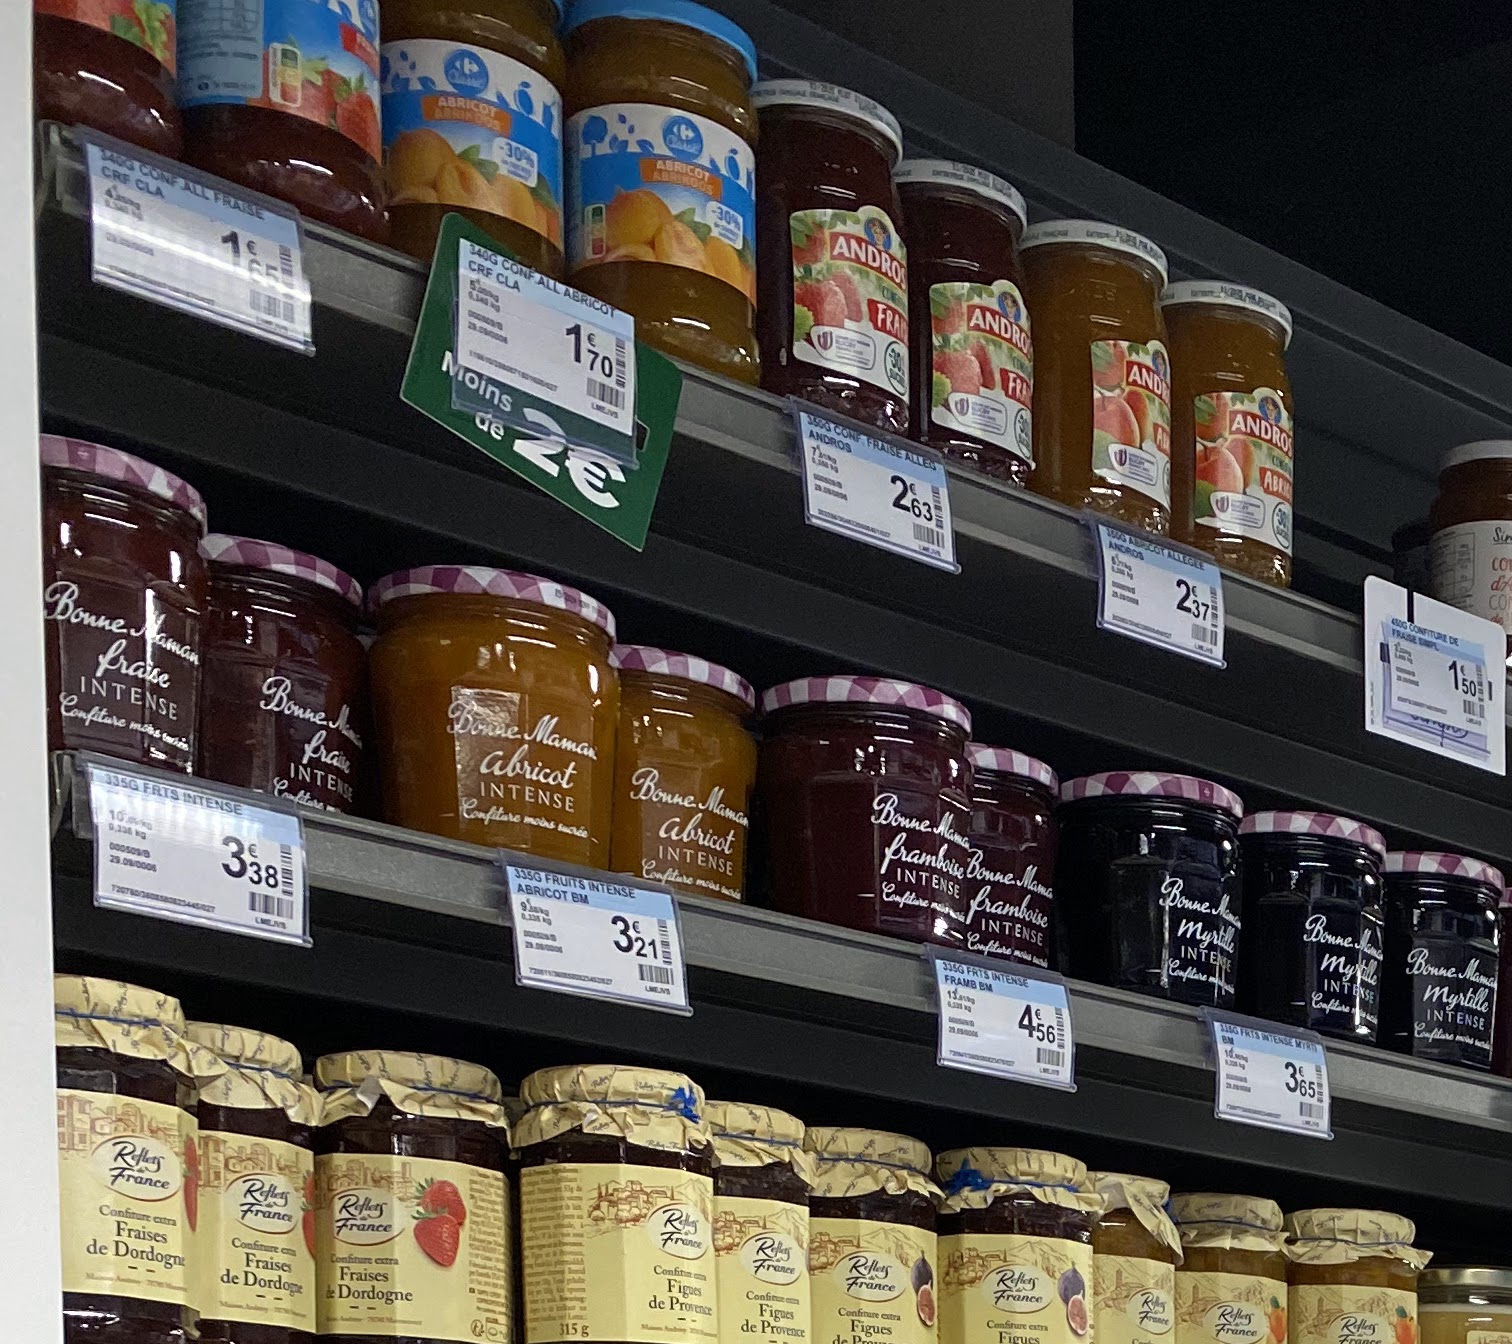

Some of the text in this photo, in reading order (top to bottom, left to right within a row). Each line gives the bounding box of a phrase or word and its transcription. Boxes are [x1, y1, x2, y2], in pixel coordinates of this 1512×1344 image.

[436, 96, 498, 116] ABRICOT
[467, 261, 521, 293] CRF CLA
[562, 285, 616, 319] ABRICOT
[441, 349, 513, 413] Moins
[475, 409, 505, 441] de
[513, 409, 626, 508] 2€
[47, 581, 126, 634] Bonne
[96, 642, 171, 690] fraise
[81, 676, 178, 721] INTENSE
[449, 701, 598, 760] Bonne Maman
[481, 750, 575, 791] abricot
[481, 780, 575, 813] INTENSE
[881, 833, 965, 880] framboise
[517, 884, 568, 903] ABRICOT
[588, 881, 636, 899] INTENSE
[897, 868, 960, 899] INTENSE
[1406, 948, 1458, 978] Bonne
[944, 975, 975, 991] FRAMB
[1425, 984, 1490, 1014] Myrtille
[1427, 1008, 1485, 1030] INTENSE
[109, 1168, 170, 1193] France
[116, 1221, 168, 1244] Fraises
[340, 1268, 389, 1283] Fraises
[338, 1285, 413, 1305] Dordogne
[850, 1320, 892, 1338] Figues
